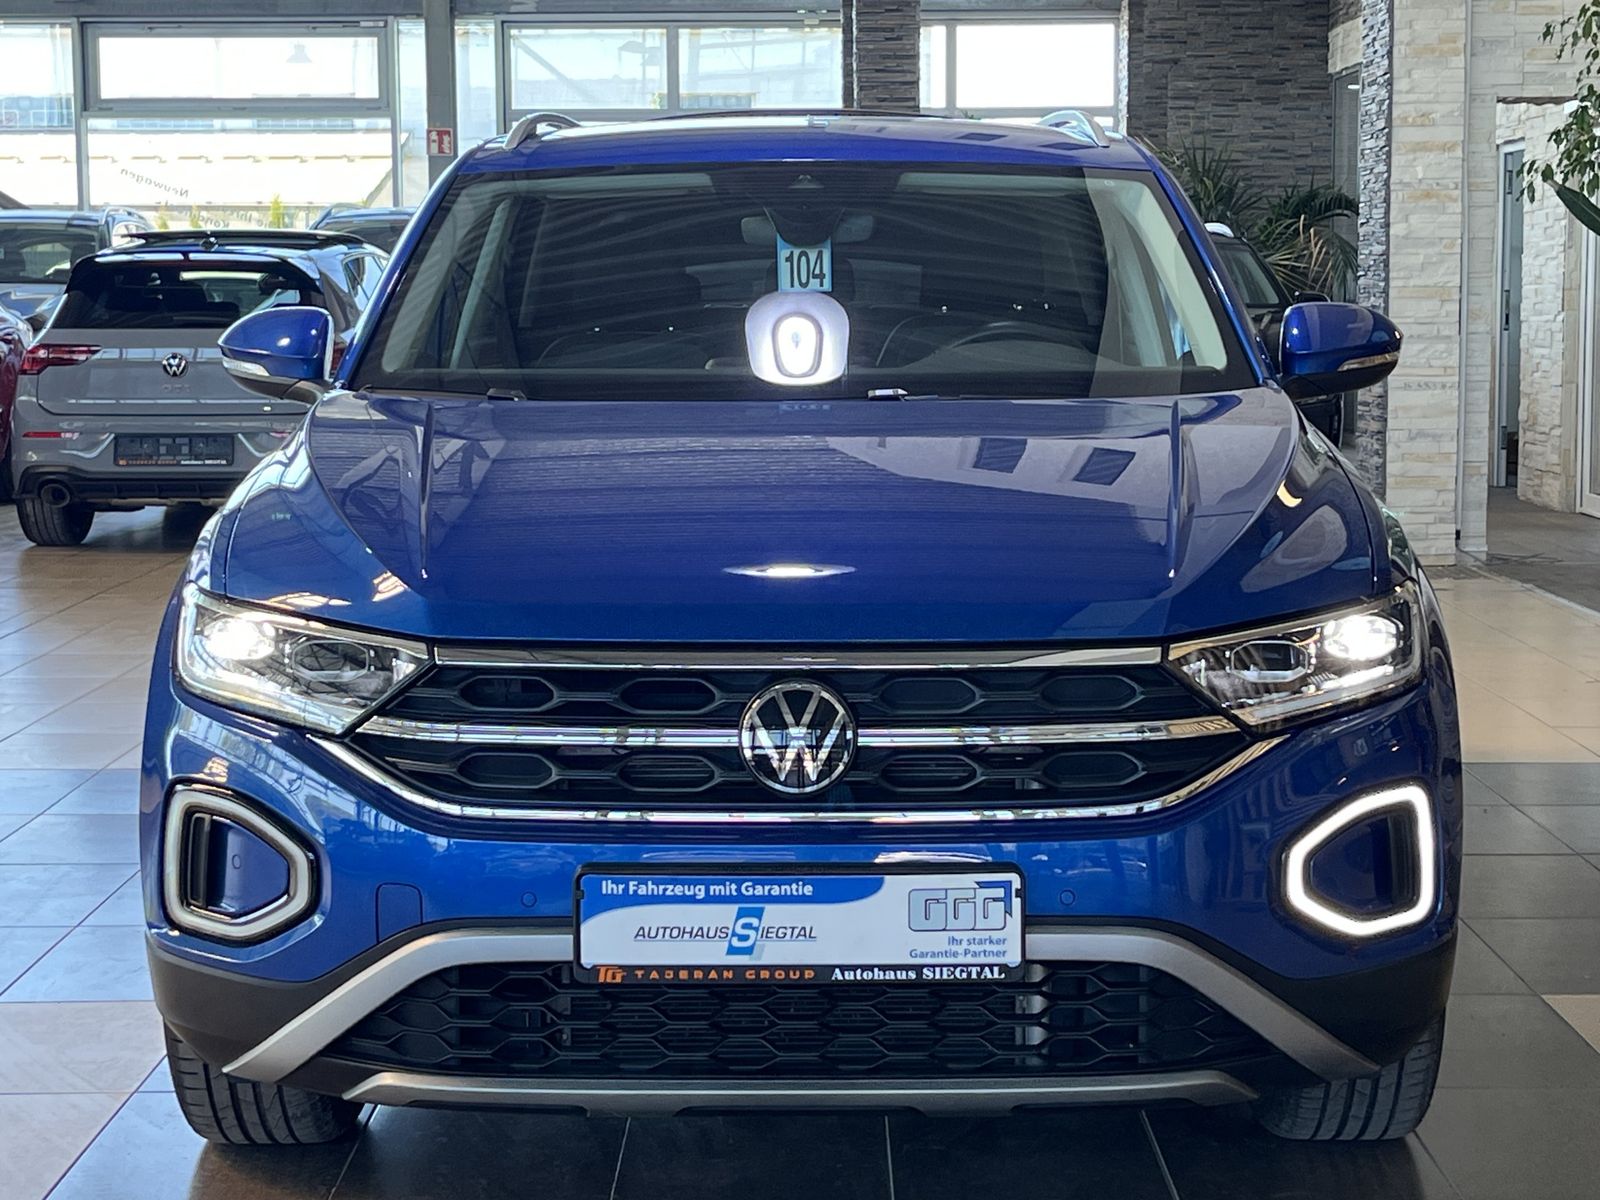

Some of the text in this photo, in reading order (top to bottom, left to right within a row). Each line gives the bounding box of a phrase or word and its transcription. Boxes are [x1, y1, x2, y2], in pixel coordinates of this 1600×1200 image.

[785, 250, 826, 288] 104
[602, 880, 813, 898] Ihr Fahrzeug mit Garantie
[948, 936, 1007, 946] Ihr starker
[909, 948, 1007, 958] Garantie-Partner
[745, 970, 815, 980] GROUP
[831, 968, 917, 981] Autohaus
[922, 966, 1006, 980] SIEGTAL
